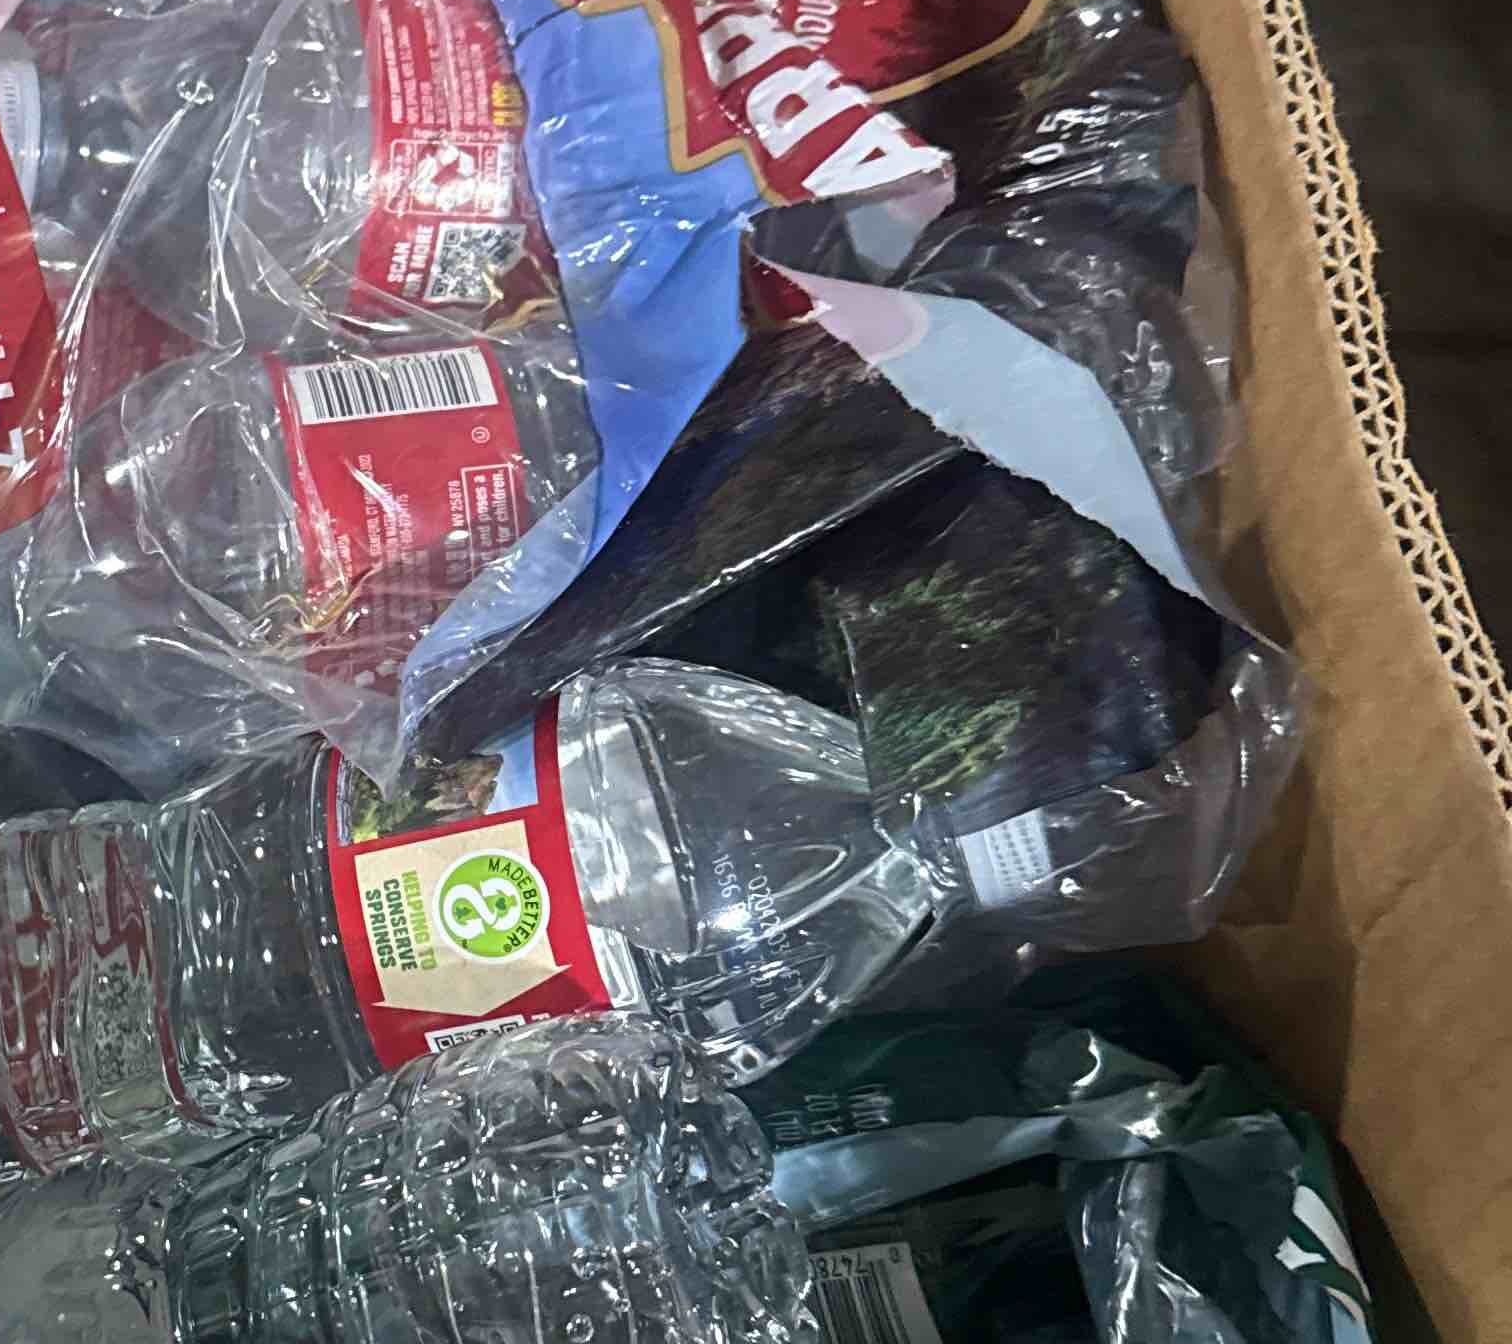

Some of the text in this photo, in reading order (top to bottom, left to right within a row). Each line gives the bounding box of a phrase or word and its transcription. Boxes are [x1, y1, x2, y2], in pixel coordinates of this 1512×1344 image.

[388, 241, 411, 284] SCAN
[409, 225, 435, 270] MORE
[474, 485, 492, 526] poses
[491, 469, 511, 522] children.
[365, 888, 398, 970] SPRINGS
[382, 877, 419, 973] CONSERVE
[401, 868, 439, 972] HELPING TO
